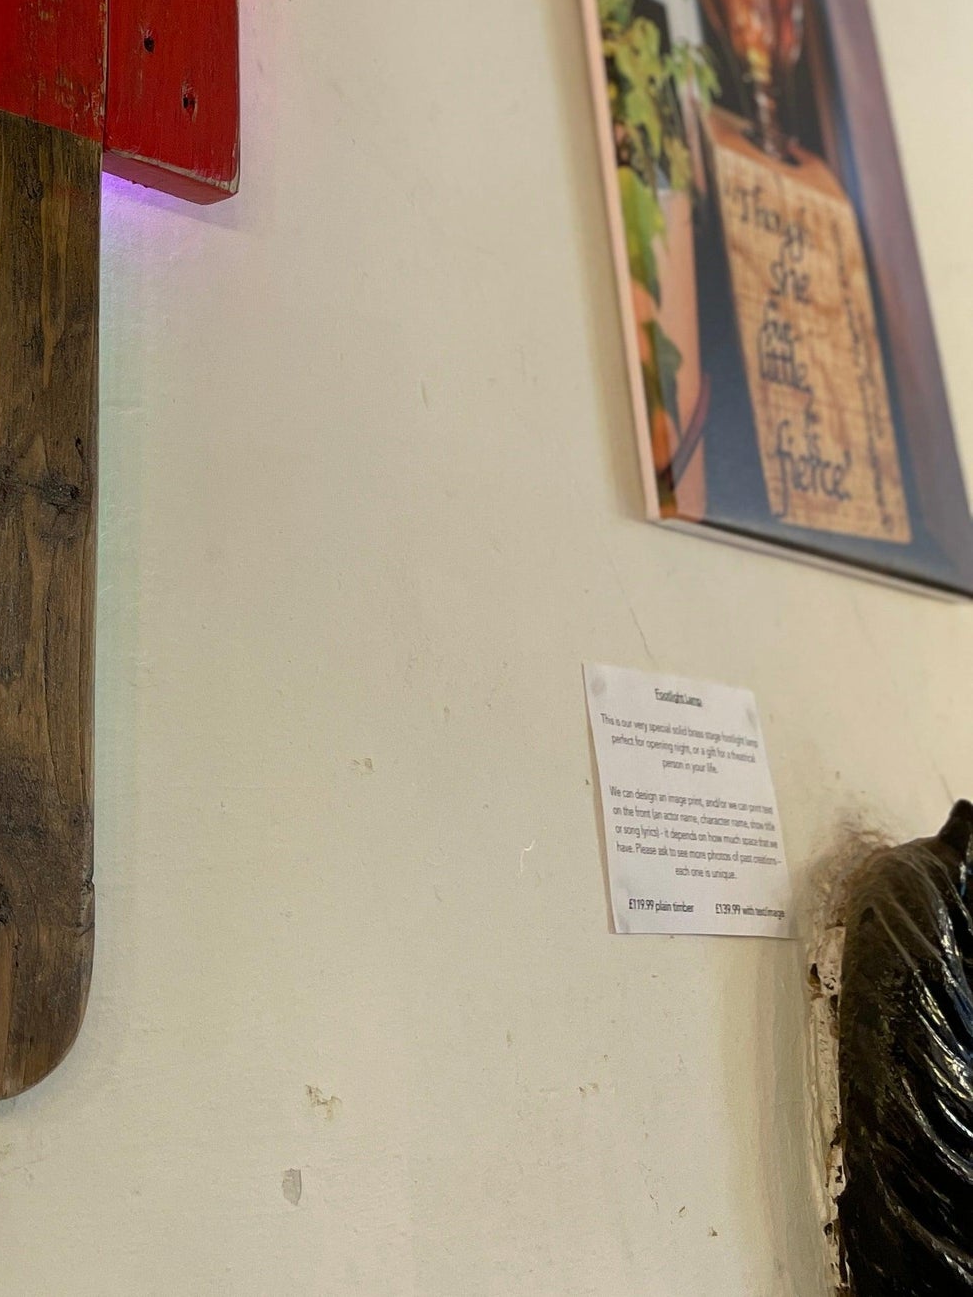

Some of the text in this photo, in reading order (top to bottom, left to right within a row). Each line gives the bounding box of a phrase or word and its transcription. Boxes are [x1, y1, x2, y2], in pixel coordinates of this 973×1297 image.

[600, 712, 614, 725] This
[615, 717, 620, 726] is
[622, 719, 632, 728] our
[634, 722, 648, 733] very
[648, 722, 672, 734] special
[672, 724, 687, 736] solid
[688, 726, 704, 738] brass
[612, 734, 634, 746] perfect
[635, 735, 644, 746] for
[646, 740, 674, 754] opening
[692, 746, 700, 754] or
[706, 746, 716, 758] gift
[717, 747, 726, 758] for
[730, 750, 756, 763] theatrical
[662, 760, 684, 771] person
[692, 764, 706, 774] your
[706, 762, 719, 774] life.
[609, 784, 622, 797] We
[622, 790, 634, 798] can
[634, 788, 657, 804] design
[658, 794, 667, 802] an
[668, 794, 686, 806] image
[706, 797, 727, 809] and/or
[728, 802, 737, 810] we
[738, 803, 748, 811] can
[612, 806, 622, 815] on
[622, 805, 634, 817] the
[634, 806, 651, 818] front
[663, 812, 679, 821] actor
[680, 814, 700, 825] name,
[700, 813, 730, 826] character
[614, 825, 622, 834] or
[624, 826, 640, 838] song
[670, 828, 698, 842] depends
[698, 834, 706, 842] on
[707, 831, 722, 842] how
[723, 833, 742, 844] much
[742, 838, 758, 846] space
[758, 836, 768, 848] that
[616, 840, 635, 854] have.
[635, 842, 657, 855] Please
[658, 845, 668, 856] ask
[669, 848, 676, 857] to
[677, 850, 688, 858] see
[689, 850, 706, 860] more
[707, 850, 732, 862] photos
[732, 850, 739, 862] of
[740, 854, 752, 864] past
[675, 865, 690, 876] each
[691, 868, 704, 878] one
[712, 869, 737, 881] unique.
[628, 898, 694, 914] £119.99 plain timber
[716, 903, 740, 914] £139.99
